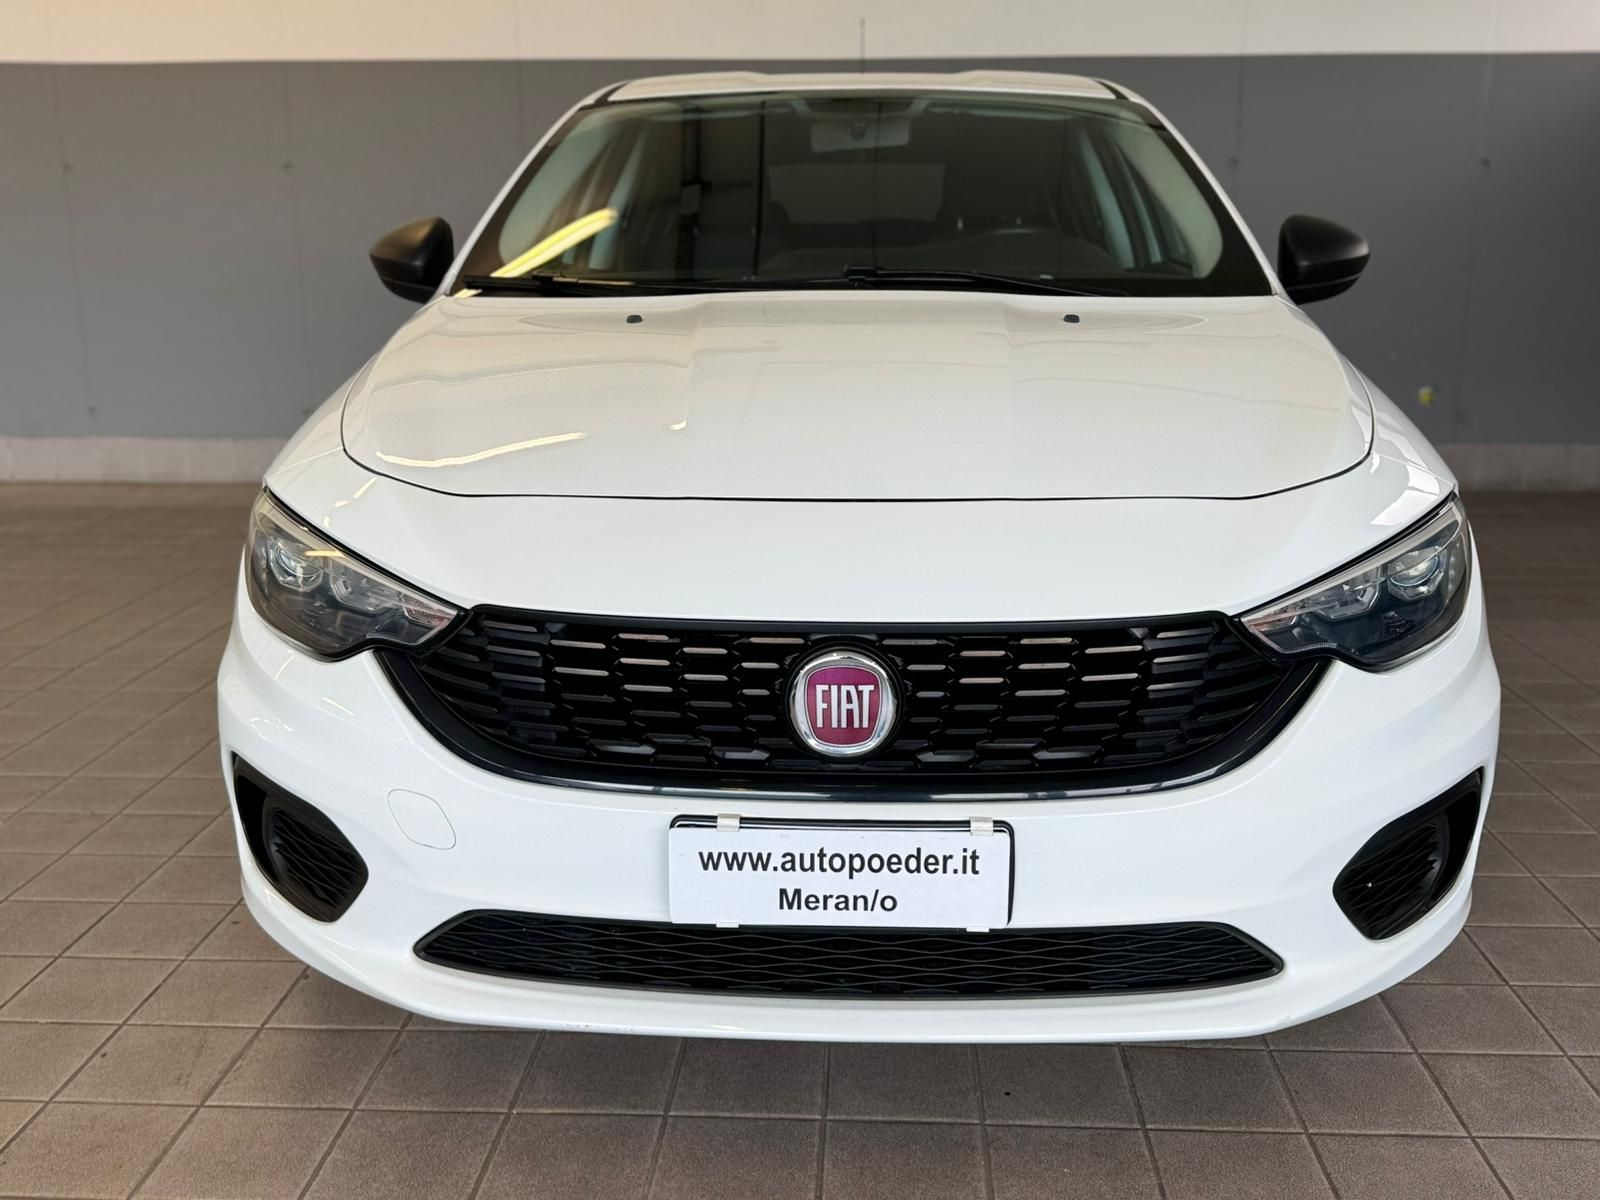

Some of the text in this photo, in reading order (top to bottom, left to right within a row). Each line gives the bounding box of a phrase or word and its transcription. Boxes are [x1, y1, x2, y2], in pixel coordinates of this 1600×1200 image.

[816, 685, 875, 728] FIAT
[698, 847, 980, 879] www.autopoeder.it
[778, 888, 898, 912] Meran/o
